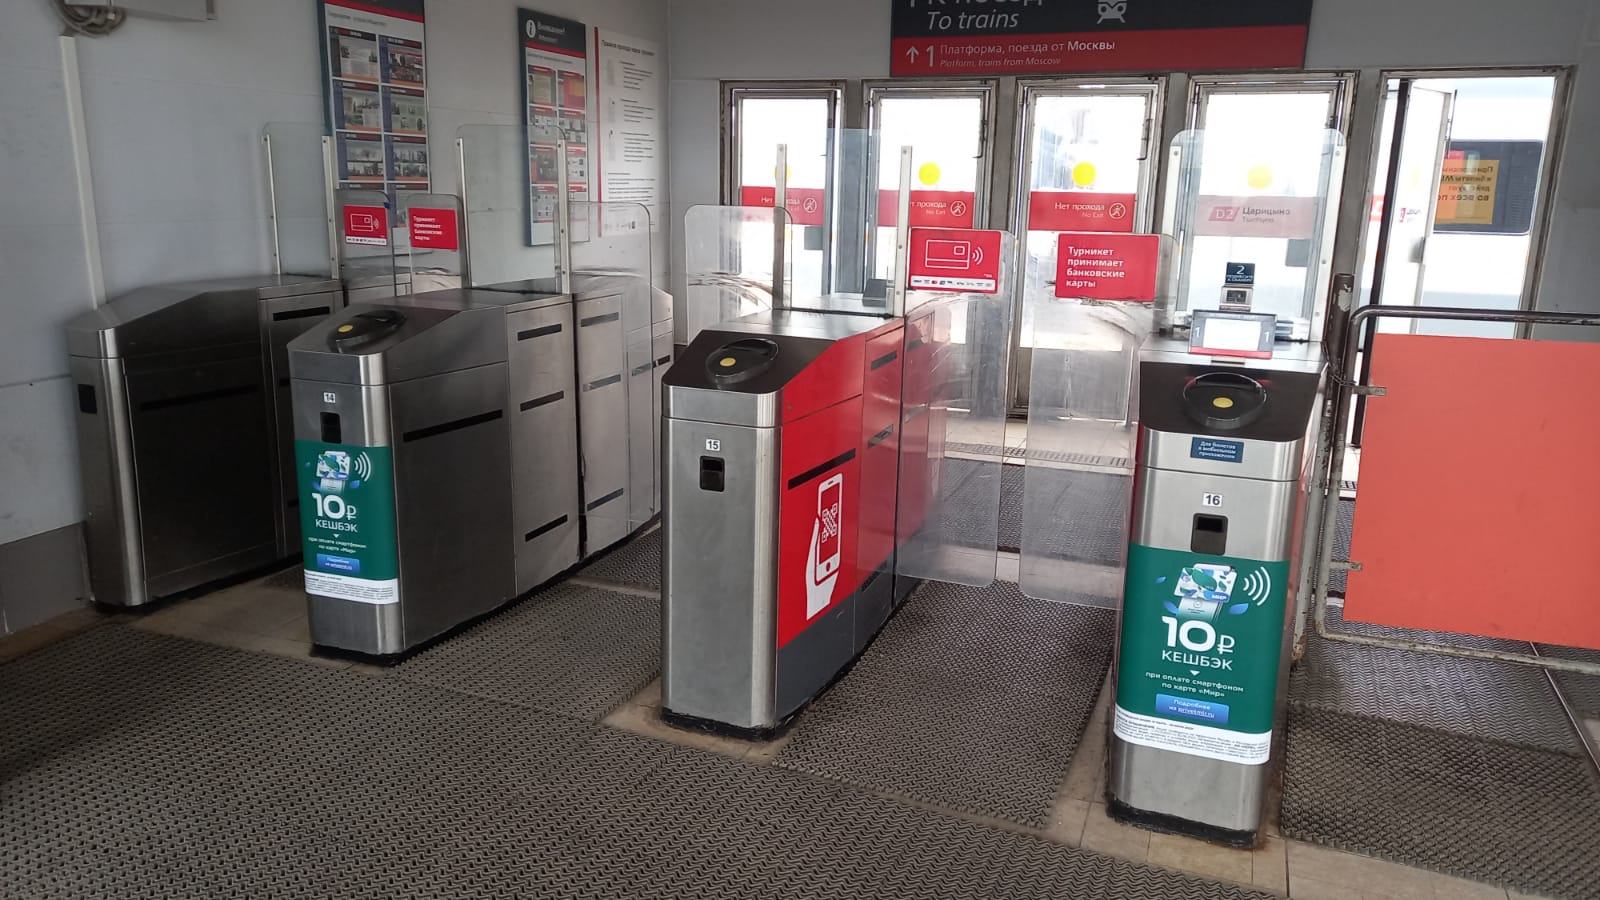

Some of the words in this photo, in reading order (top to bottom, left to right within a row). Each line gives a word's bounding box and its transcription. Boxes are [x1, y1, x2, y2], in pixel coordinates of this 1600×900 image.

[928, 11, 951, 30] To
[958, 9, 1019, 29] trains
[940, 44, 1005, 56] Платформа,
[1008, 43, 1048, 53] поезда
[1051, 43, 1064, 51] от
[1067, 40, 1115, 51] Москвы
[926, 45, 934, 67] 1
[979, 59, 1001, 67] trains
[1003, 58, 1023, 67] from
[1026, 56, 1060, 65] Moscow
[1054, 202, 1070, 210] Нет
[1072, 204, 1104, 212] прохода
[1242, 207, 1290, 216] Царицыно
[1068, 246, 1114, 256] Турникет
[1067, 258, 1124, 267] принимает
[1066, 268, 1125, 278] банковские
[1236, 265, 1246, 275] 2
[1066, 280, 1096, 288] карты
[708, 440, 719, 450] 15
[1206, 494, 1220, 506] 16
[315, 519, 358, 533] КЕШБЭК
[1162, 650, 1233, 671] КЕШБЭК
[1162, 674, 1190, 684] оплате
[1192, 680, 1244, 692] смартфоном
[1174, 684, 1196, 693] карте
[1198, 688, 1225, 698] «Мир»
[1174, 700, 1211, 710] Подробнее
